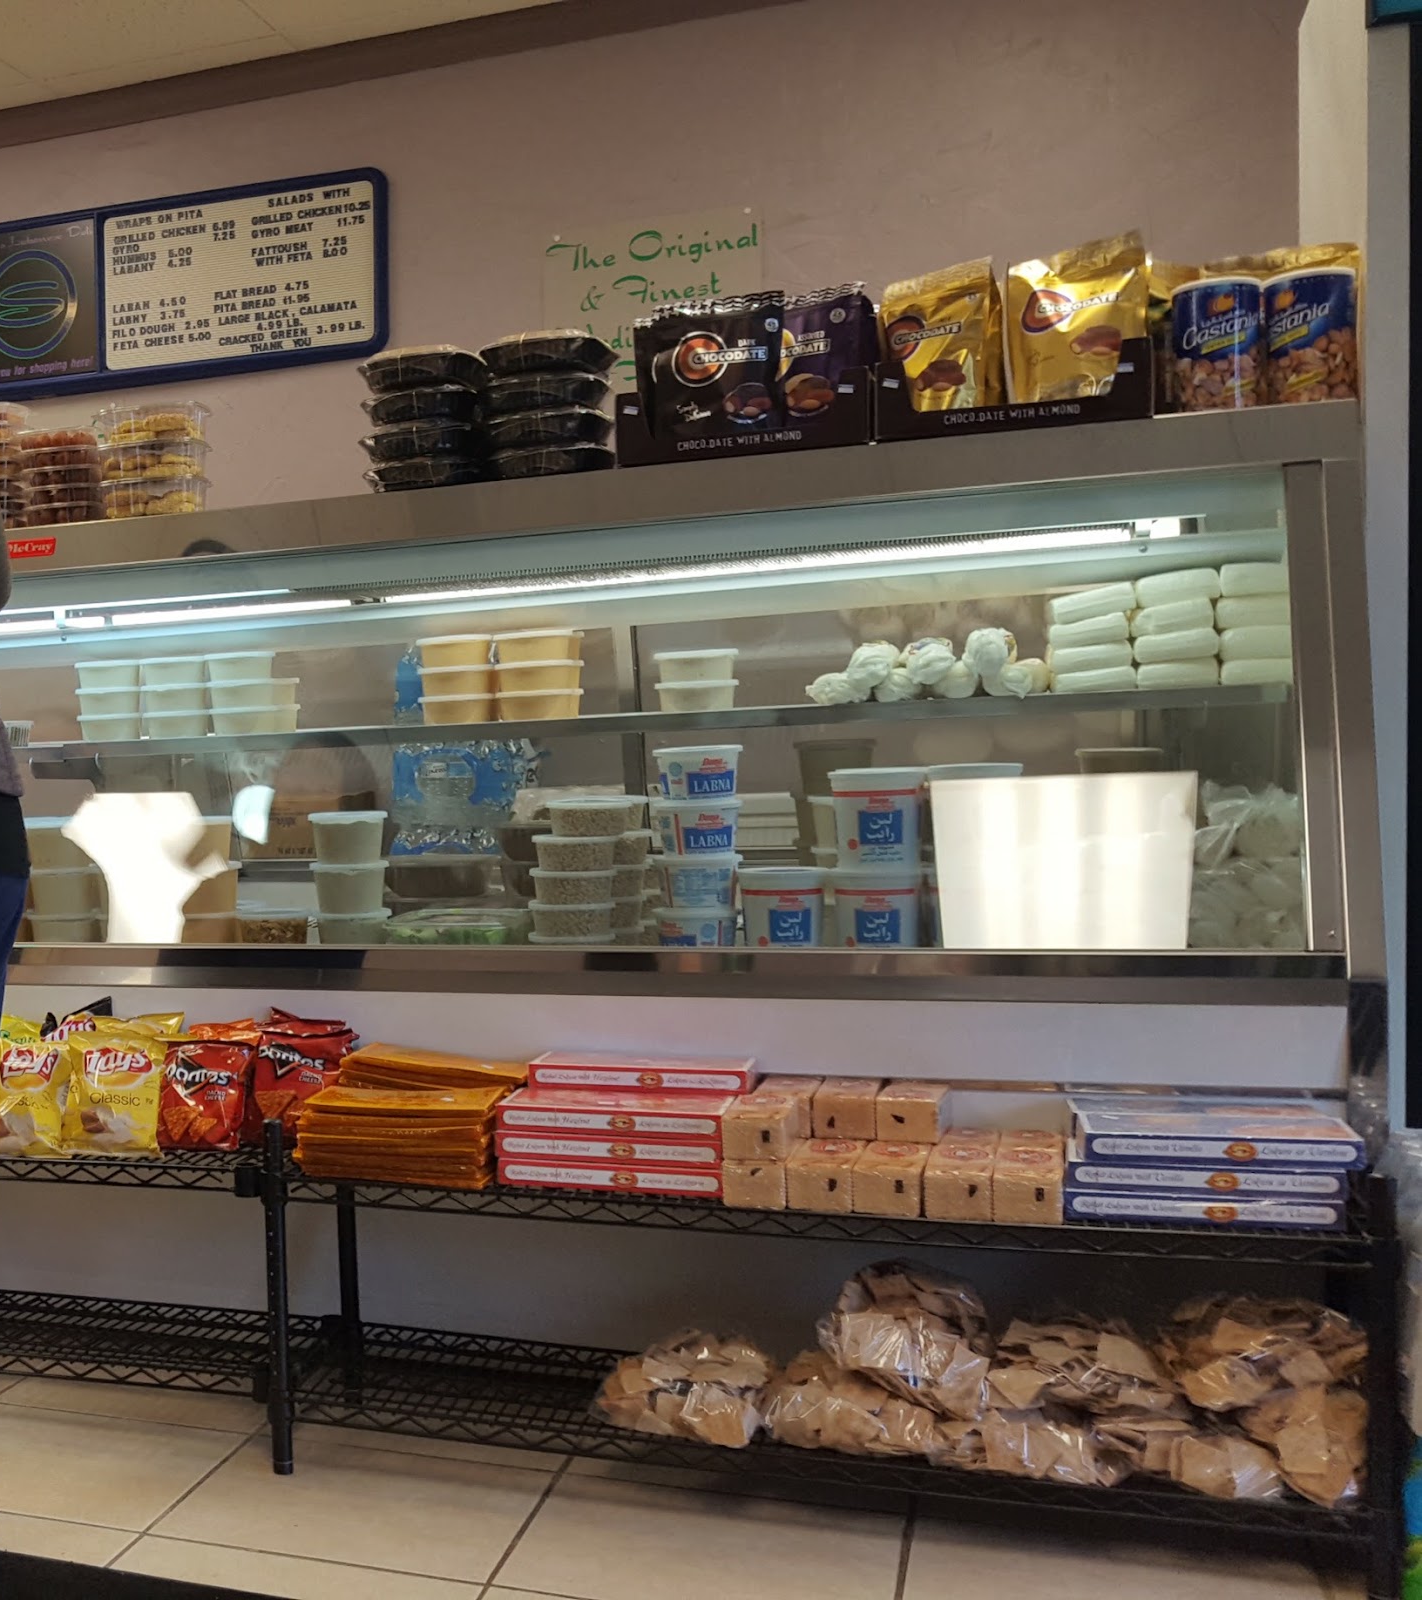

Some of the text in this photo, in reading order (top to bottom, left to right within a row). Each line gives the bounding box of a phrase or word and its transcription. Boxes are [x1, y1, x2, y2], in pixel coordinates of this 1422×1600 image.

[268, 187, 351, 208] SALADS WITH
[116, 209, 203, 229] WRAPS ON PITA
[251, 212, 293, 226] GRILLED
[297, 205, 342, 219] CHICKEN
[114, 231, 155, 245] GRILLED
[162, 224, 206, 239] CHICKEN
[251, 215, 365, 239] GYRO MEAT 11.75
[213, 230, 235, 241] 7.25
[113, 244, 139, 255] GYRO
[251, 236, 347, 257] FATTOUSH 7.25
[545, 223, 758, 271] The Original
[113, 252, 156, 266] HUMMUS
[255, 255, 283, 267] WITH
[287, 252, 313, 263] FETA
[214, 280, 309, 300] FLAT BREAD 4.75
[580, 271, 721, 313] & Finest
[159, 296, 186, 307] 4.50
[213, 302, 237, 313] PITA
[241, 298, 276, 310] BREAD
[160, 309, 185, 320] 3.75
[218, 314, 250, 326] LARGE
[299, 300, 357, 316] CALAMATA
[1270, 302, 1330, 338] stania
[140, 323, 175, 336] DOUGH
[185, 319, 210, 330] 2.95
[218, 321, 365, 346] CRACKED GREEN 3.99 LB.
[257, 320, 283, 331] 4.99
[1182, 311, 1260, 350] Castania
[113, 332, 211, 351] FETA CHEESE 5.00
[250, 338, 312, 352] THANK YOU
[780, 341, 827, 357] OCODATE
[29, 360, 67, 374] shopping
[1009, 407, 1035, 419] WITH
[1038, 403, 1081, 417] ALMOND
[737, 433, 760, 445] WITH
[763, 430, 802, 442] ALMOND
[693, 779, 732, 793] LABNA
[690, 834, 728, 848] LABNA
[89, 1091, 141, 1107] Classic
